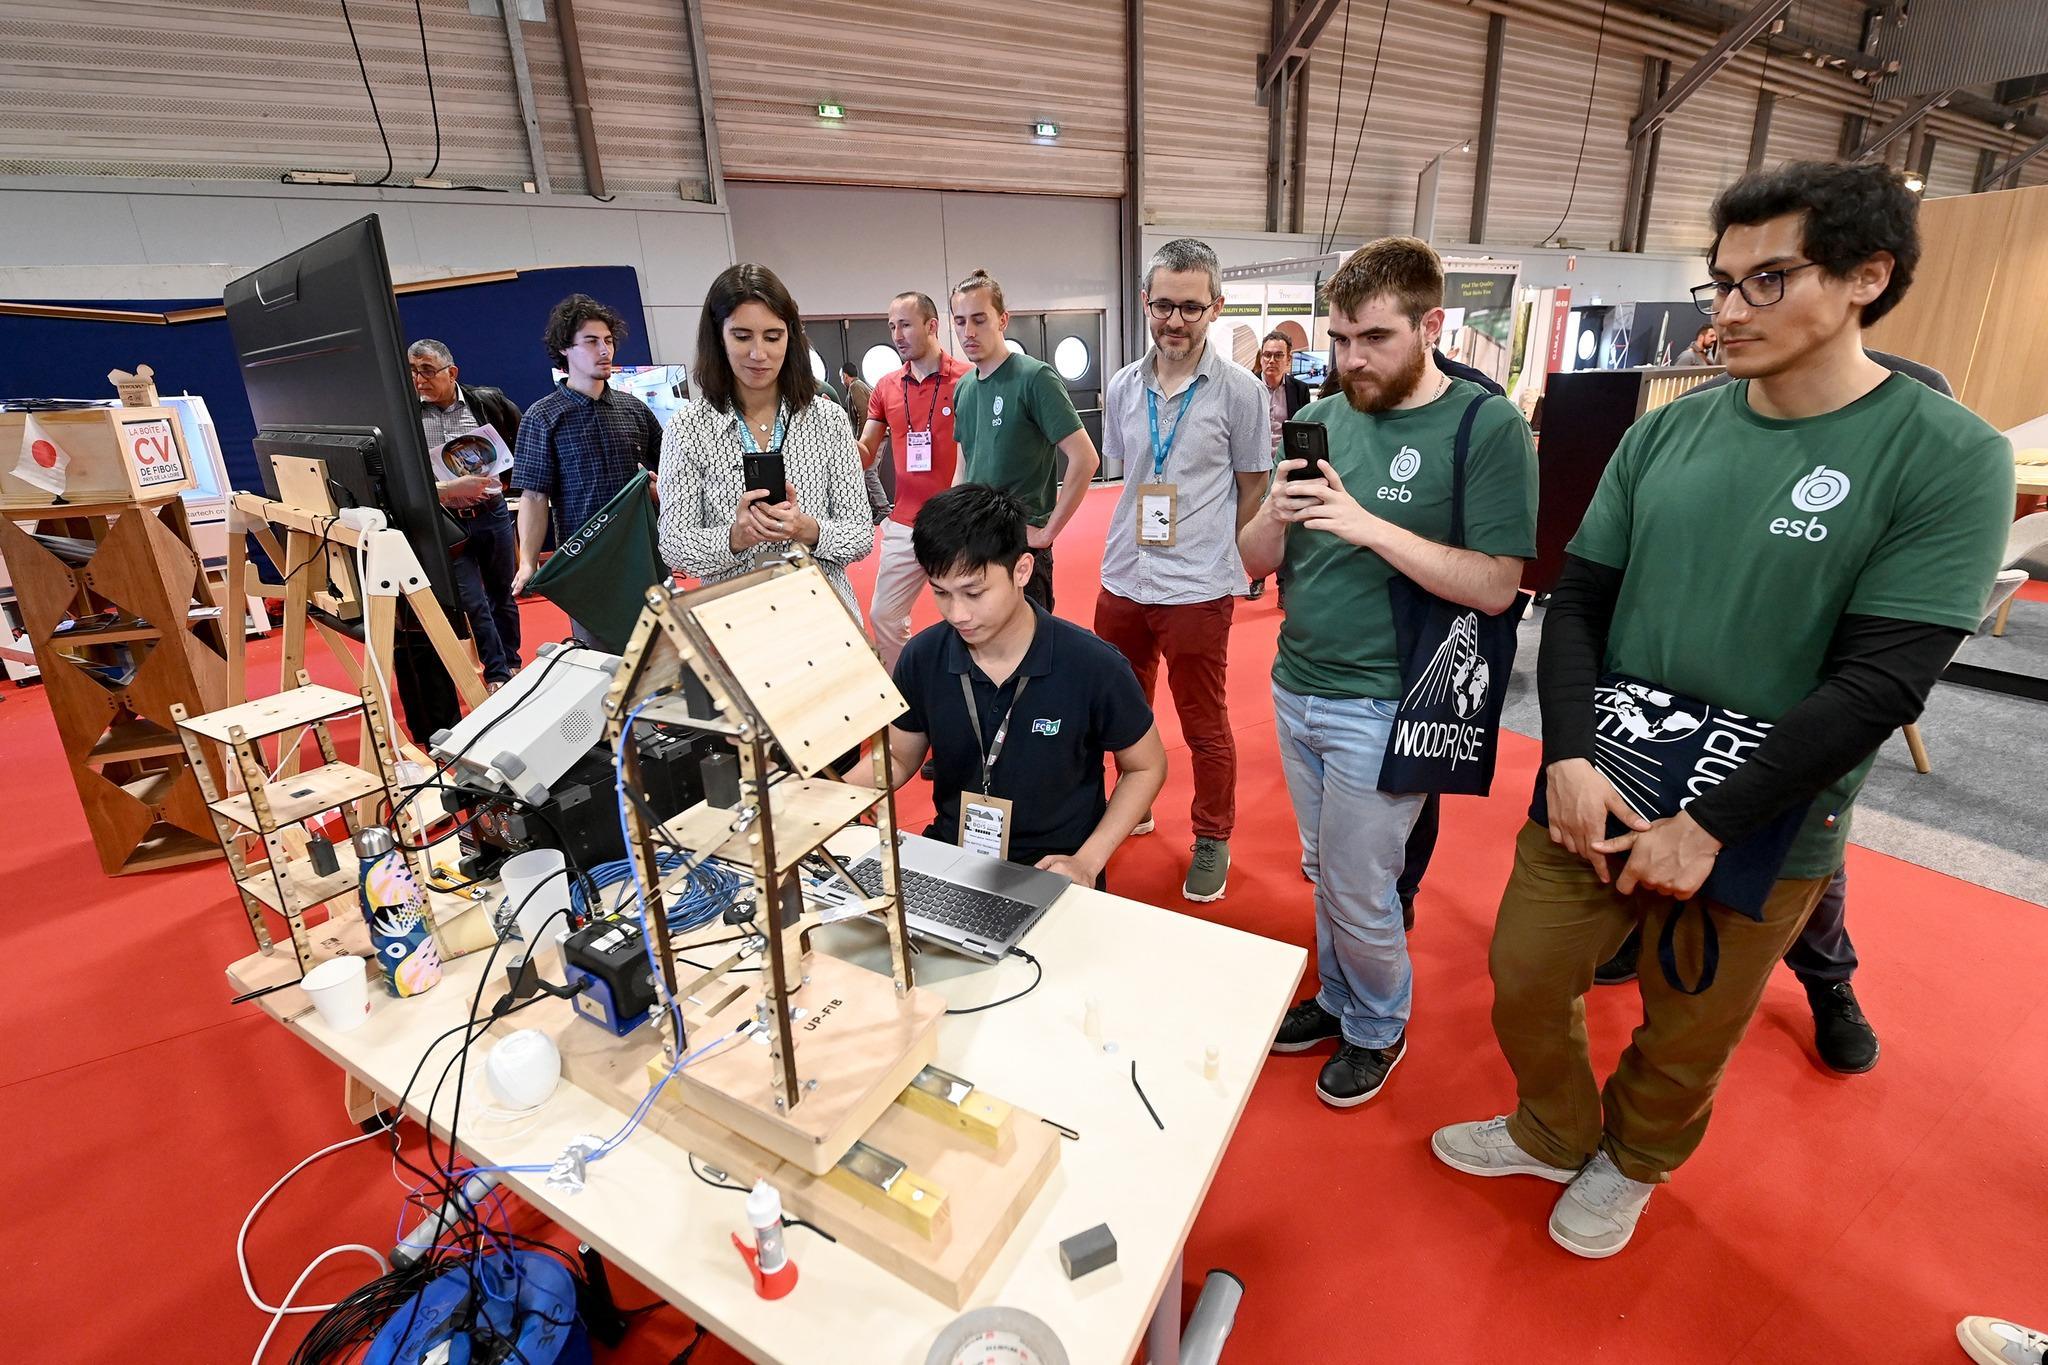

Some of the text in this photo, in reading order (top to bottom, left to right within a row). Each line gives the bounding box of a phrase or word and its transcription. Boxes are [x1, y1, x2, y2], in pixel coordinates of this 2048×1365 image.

[1479, 280, 1494, 289] Quality
[128, 427, 139, 436] LA
[135, 436, 168, 465] CV
[140, 463, 179, 477] DE FIBOIS
[166, 471, 180, 479] LOIRE
[1376, 484, 1413, 503] esb
[1769, 515, 1828, 542] esb
[1035, 722, 1057, 733] FCBA
[1394, 719, 1485, 771] WOODRISE
[803, 998, 843, 1031] UP-FIB
